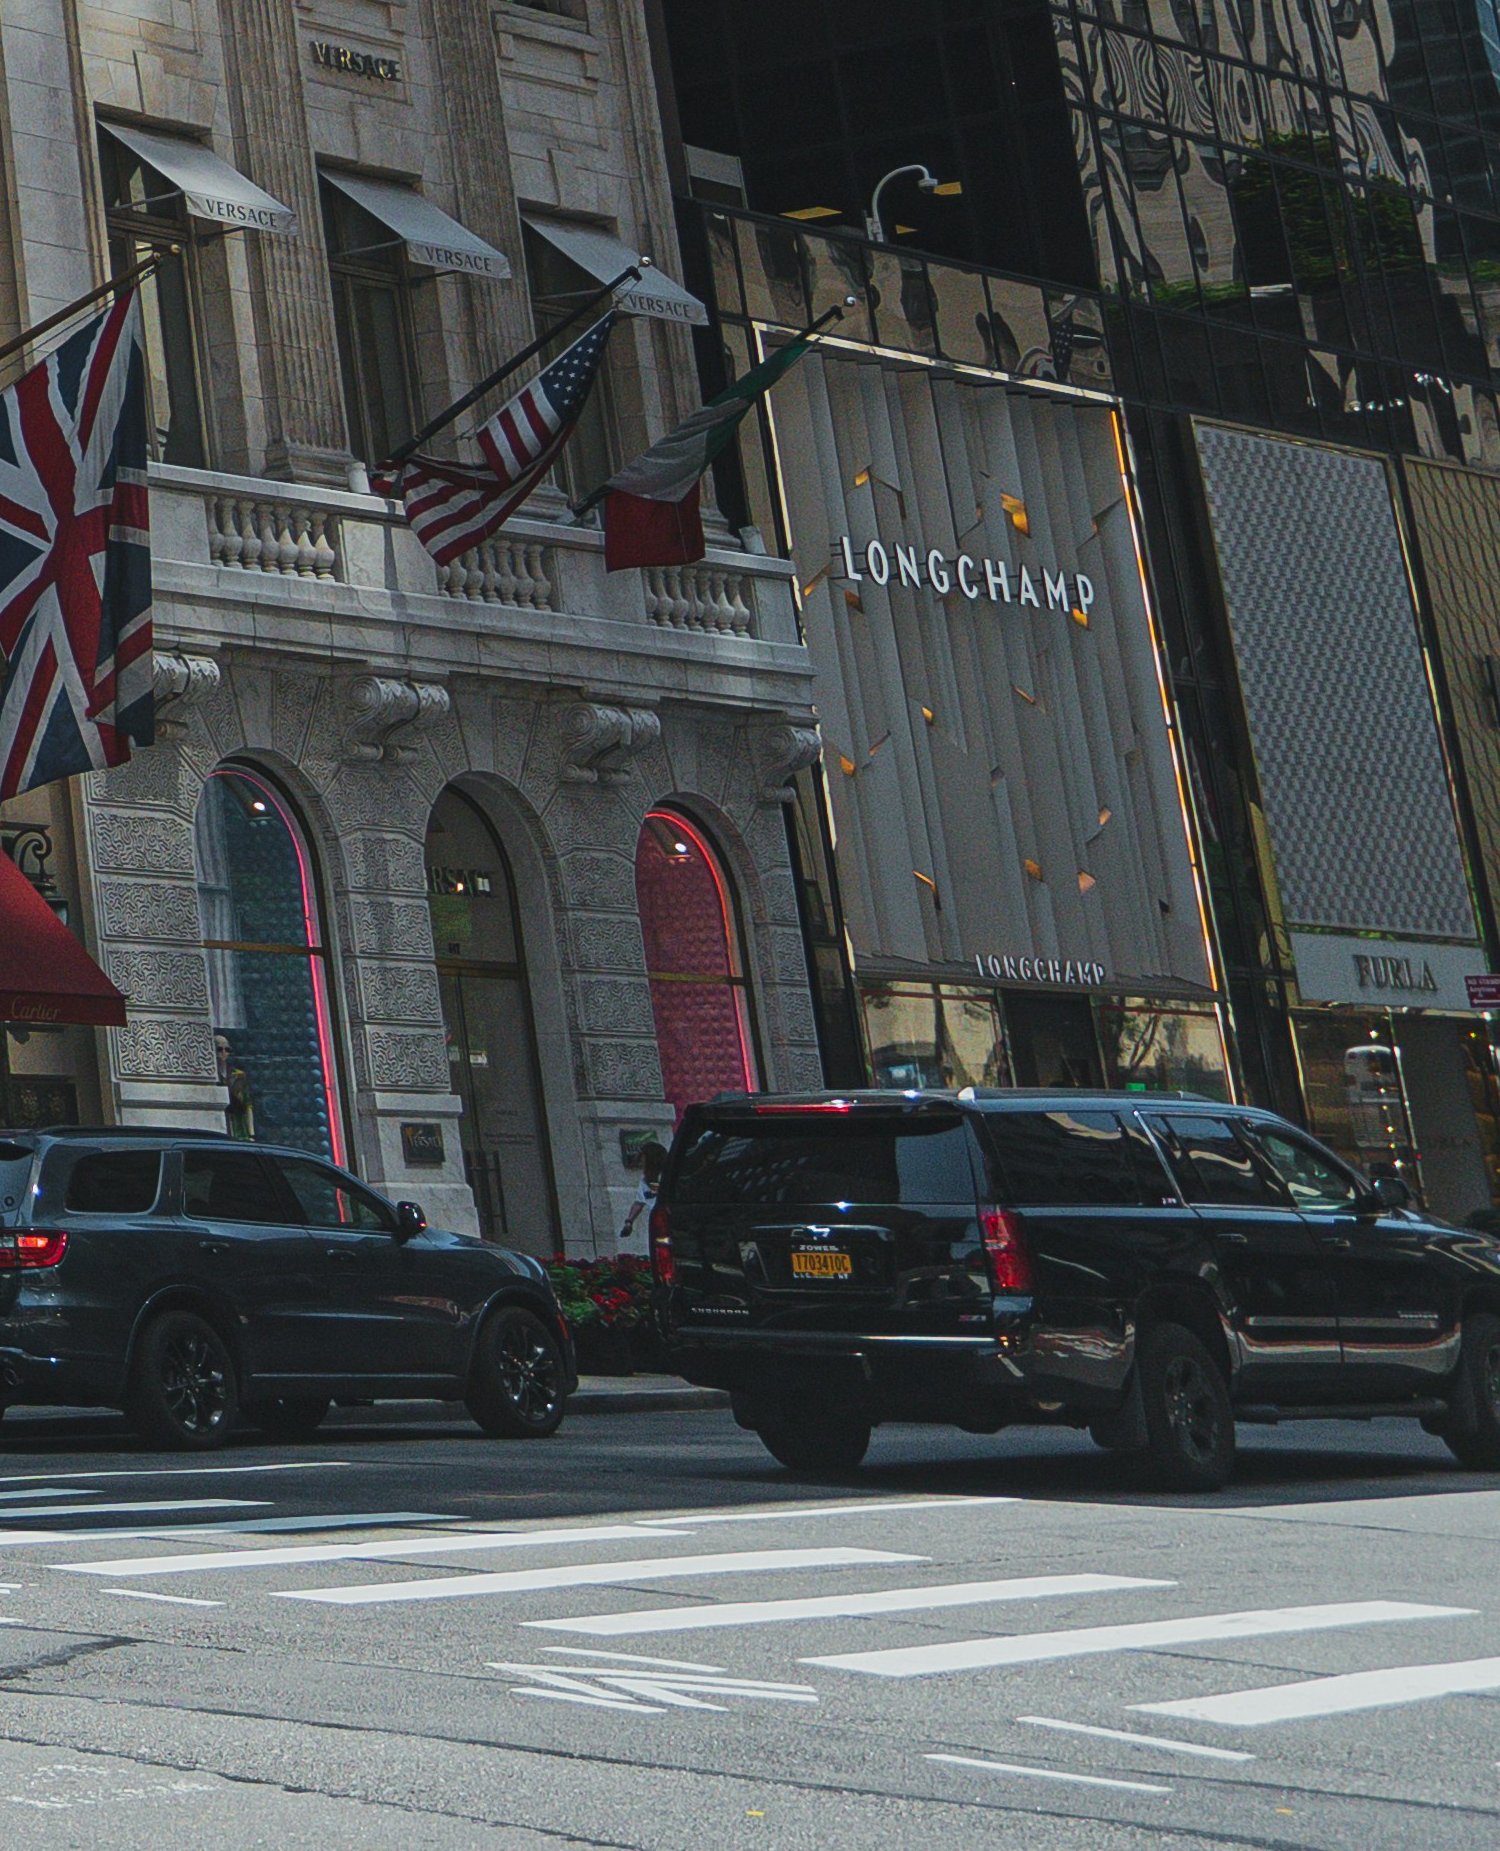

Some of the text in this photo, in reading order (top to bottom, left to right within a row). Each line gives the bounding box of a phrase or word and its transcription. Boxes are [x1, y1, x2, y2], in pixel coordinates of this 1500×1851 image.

[309, 40, 401, 82] VERSACE
[205, 198, 278, 228] VERSACE
[425, 246, 493, 273] VERSACE
[627, 294, 691, 319] VERSACE
[839, 536, 1095, 615] LONGCHAMP
[975, 953, 1106, 986] LONGCHAMP
[1352, 954, 1439, 992] FURLA
[11, 996, 61, 1021] Cartier
